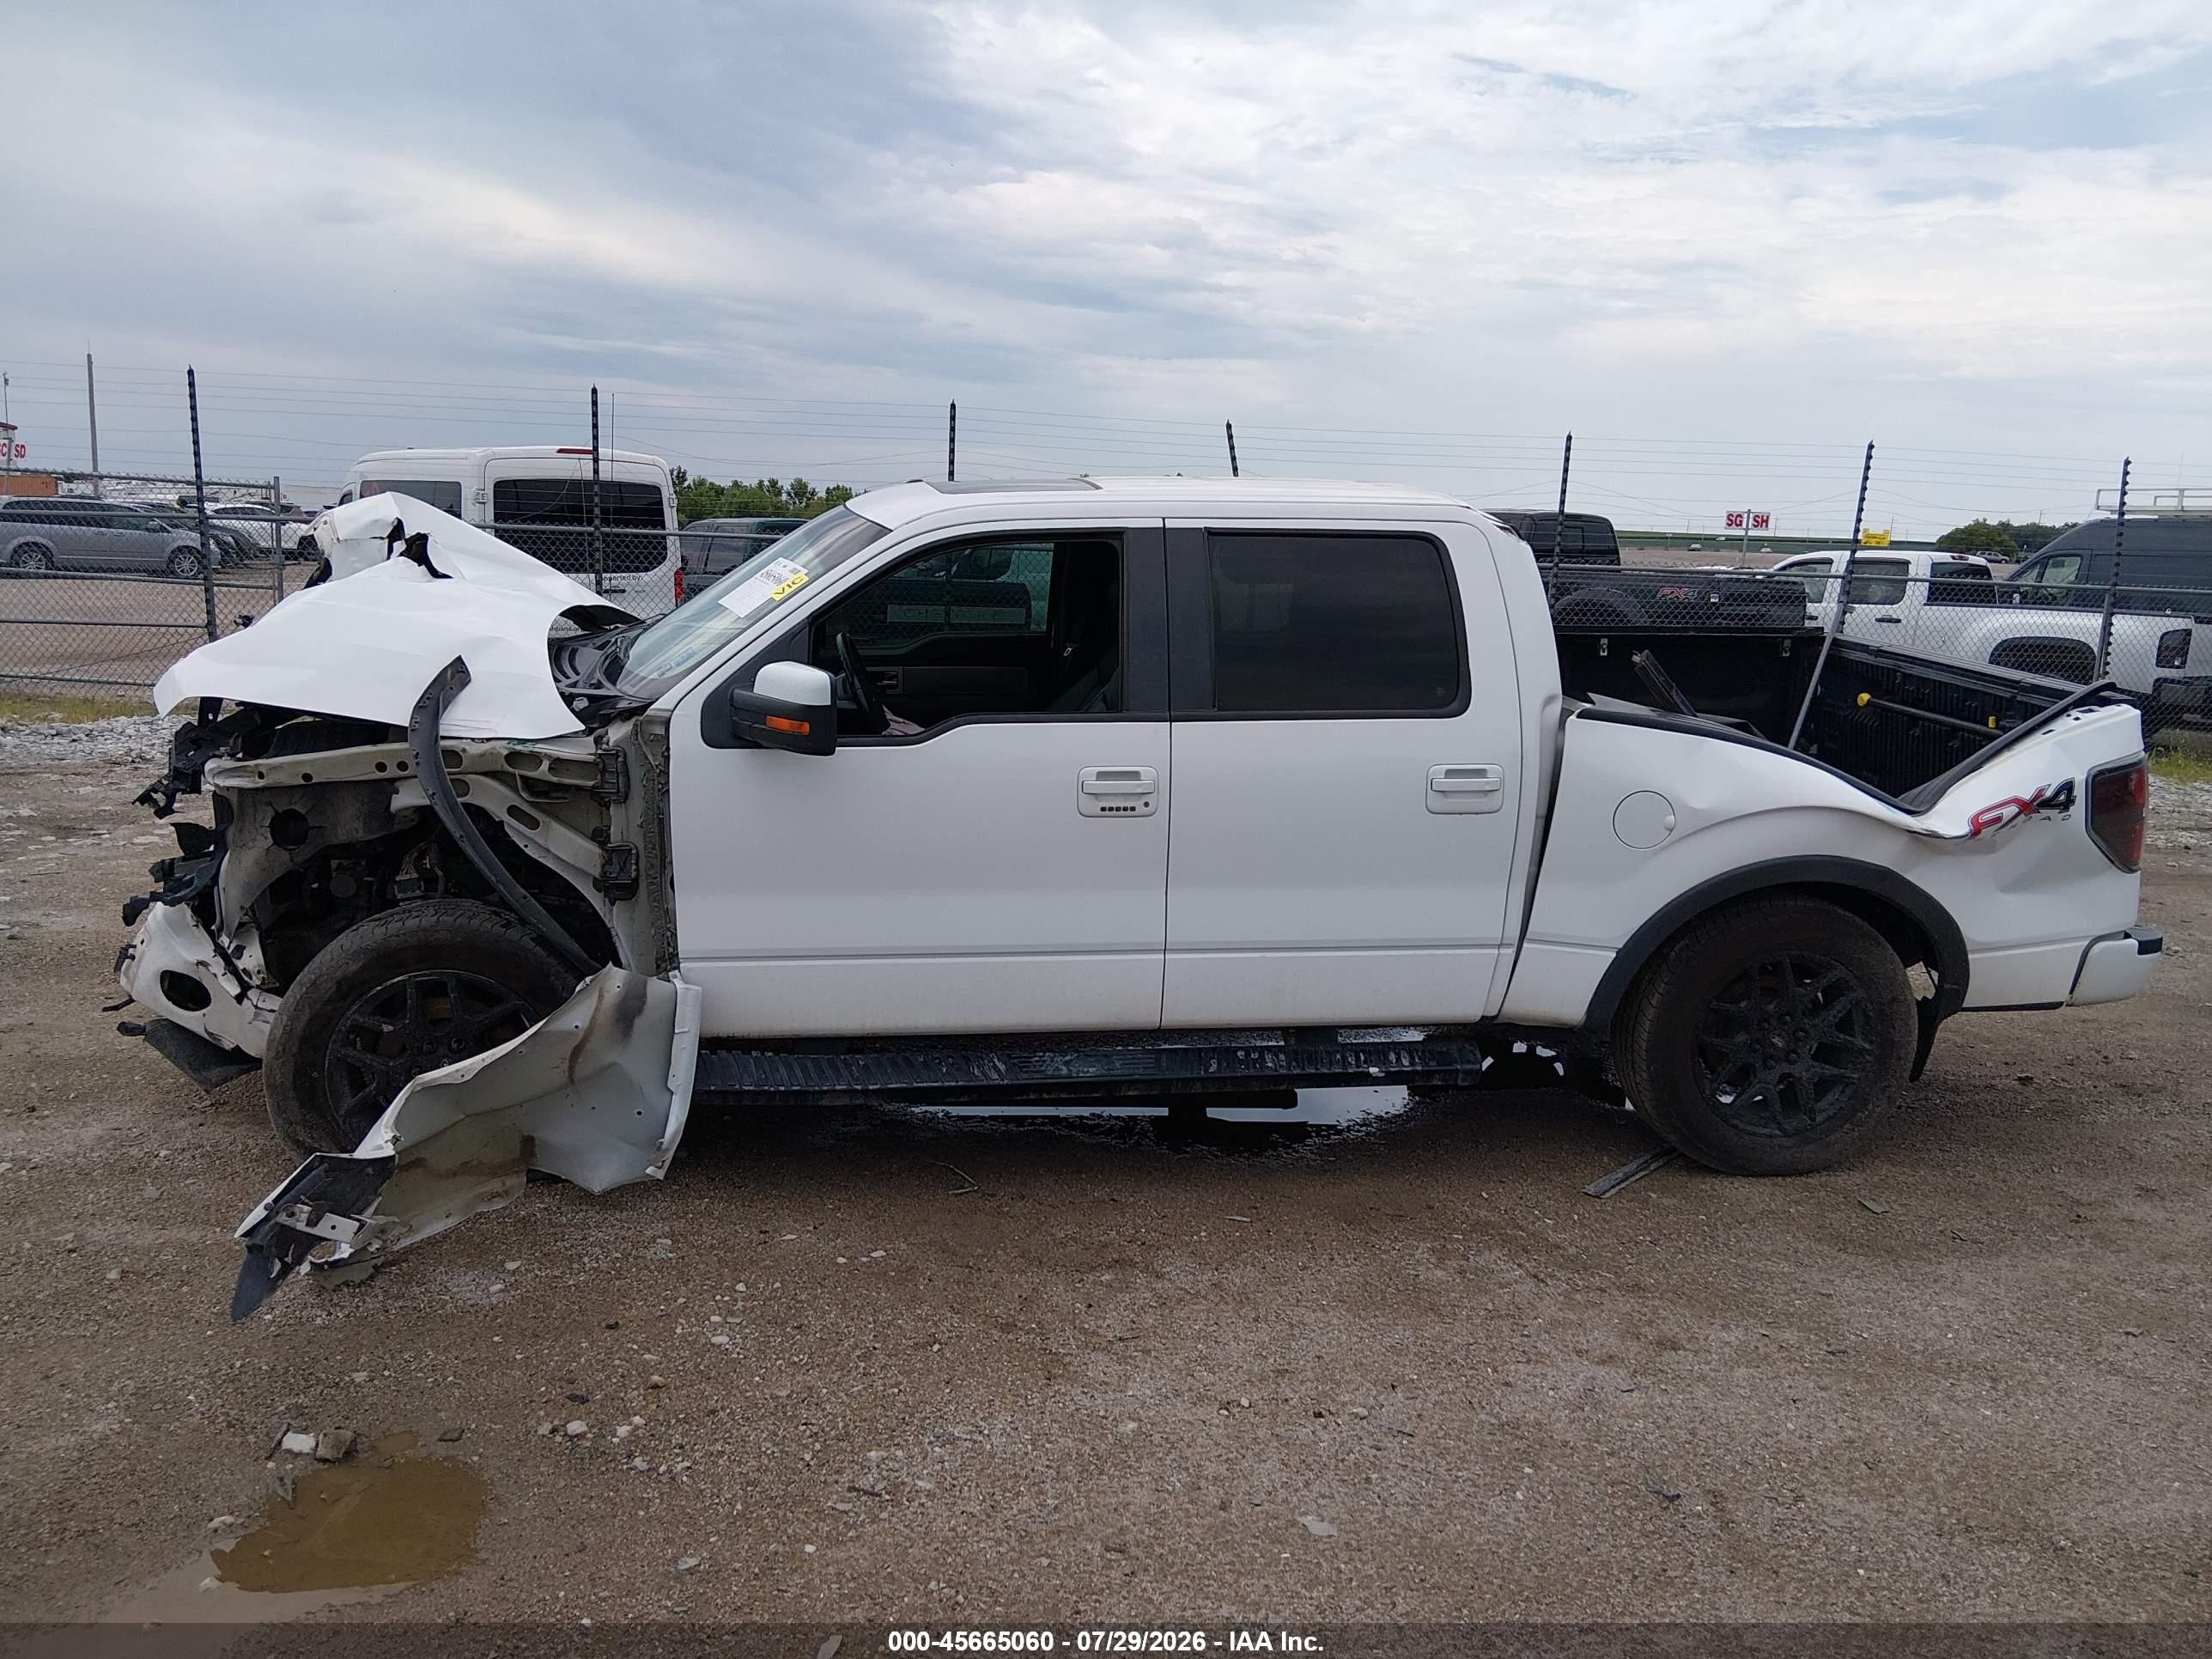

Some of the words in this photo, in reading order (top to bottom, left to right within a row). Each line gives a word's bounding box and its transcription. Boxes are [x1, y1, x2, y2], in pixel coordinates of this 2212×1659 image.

[0, 443, 8, 457] C
[14, 443, 27, 459] SD
[1726, 514, 1743, 527] SG
[1752, 514, 1770, 529] SH
[1657, 586, 1698, 599] FX4
[1968, 777, 2078, 838] FX4
